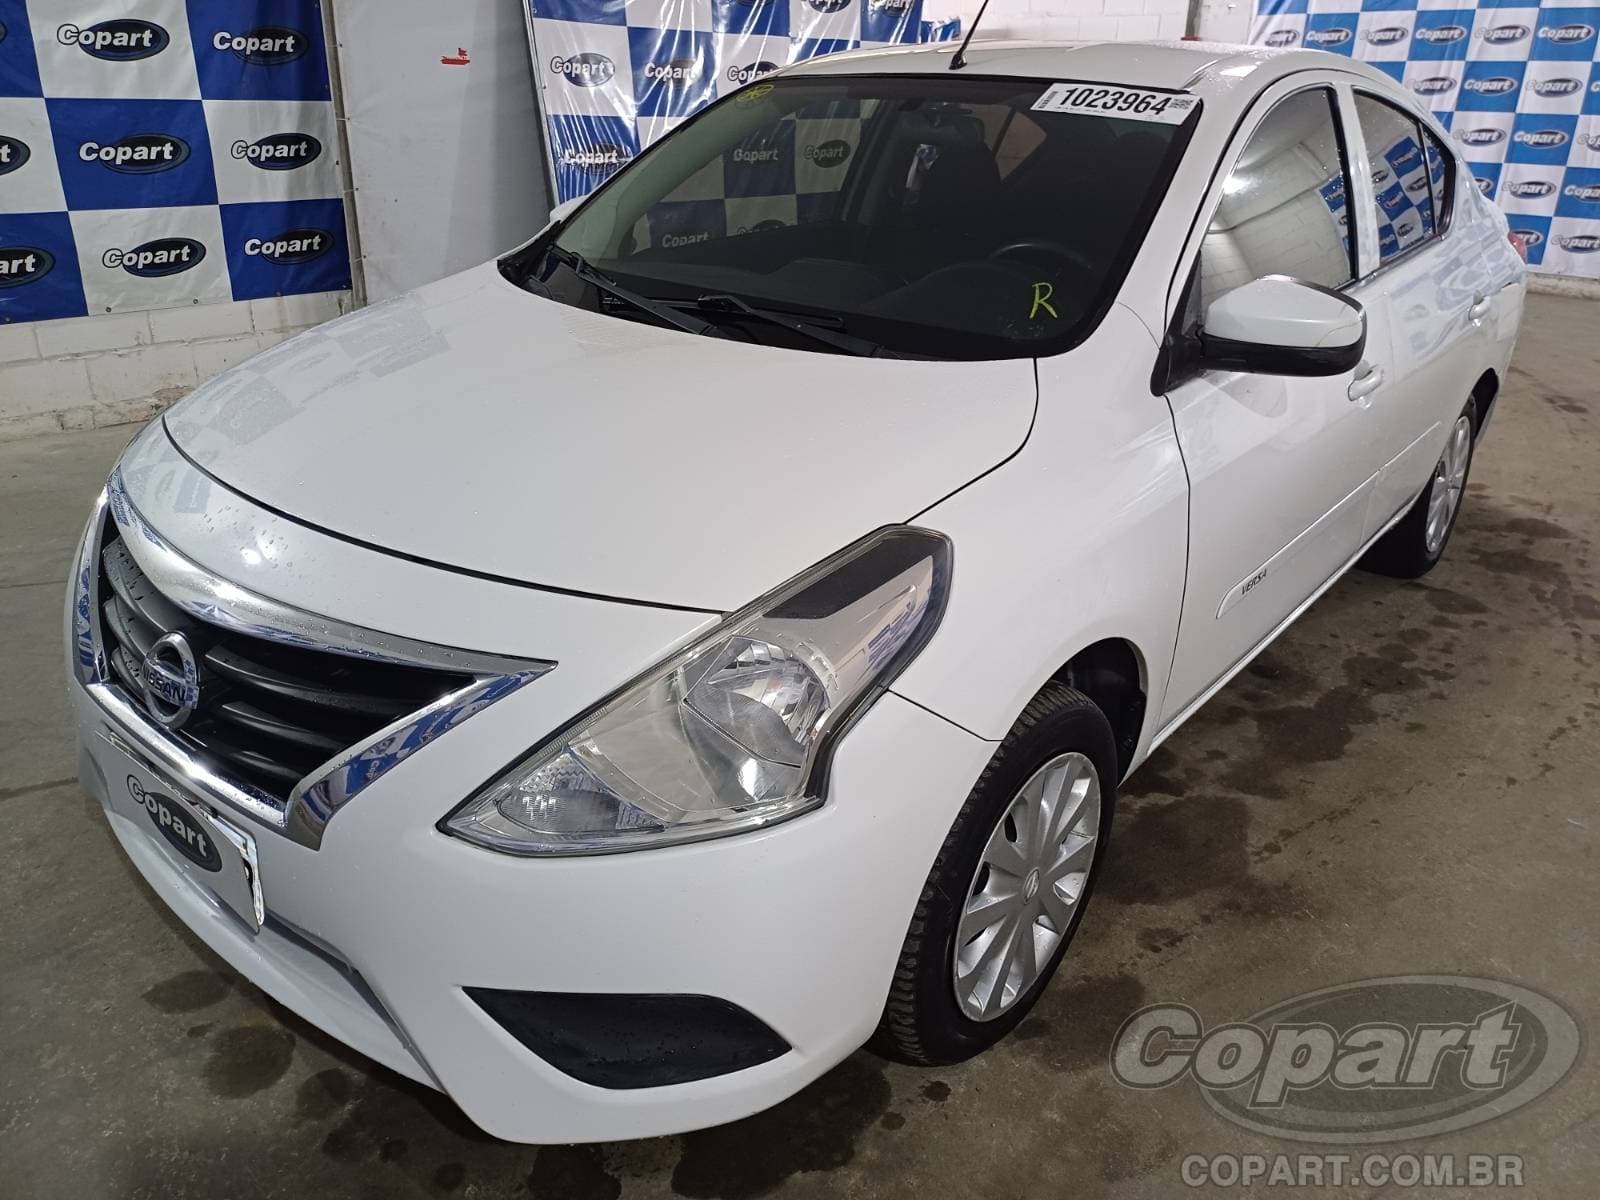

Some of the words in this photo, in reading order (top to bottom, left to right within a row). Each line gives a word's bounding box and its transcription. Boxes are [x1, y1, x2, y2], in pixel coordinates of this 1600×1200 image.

[57, 24, 153, 49] Copart
[213, 31, 295, 54] Copart
[1305, 31, 1346, 42] Copart
[1360, 29, 1402, 42] Copart
[1415, 28, 1461, 41] Copart
[1474, 27, 1523, 41] Copart
[1538, 26, 1588, 41] Copart
[550, 56, 605, 78] Copart
[1464, 78, 1511, 92] Copart
[1525, 78, 1575, 92] Copart
[1060, 88, 1172, 115] 1023964
[1453, 129, 1498, 142] Copart
[1513, 130, 1561, 145] Copart
[79, 141, 173, 164] Copart
[231, 139, 307, 158] Copart
[1501, 181, 1549, 194] Copart
[1564, 184, 1600, 198] Copa
[244, 234, 321, 257] Copart
[0, 253, 36, 274] art
[102, 244, 191, 269] Copart
[1030, 282, 1057, 318] R
[142, 661, 187, 705] NISSAN
[127, 774, 208, 857] Copart
